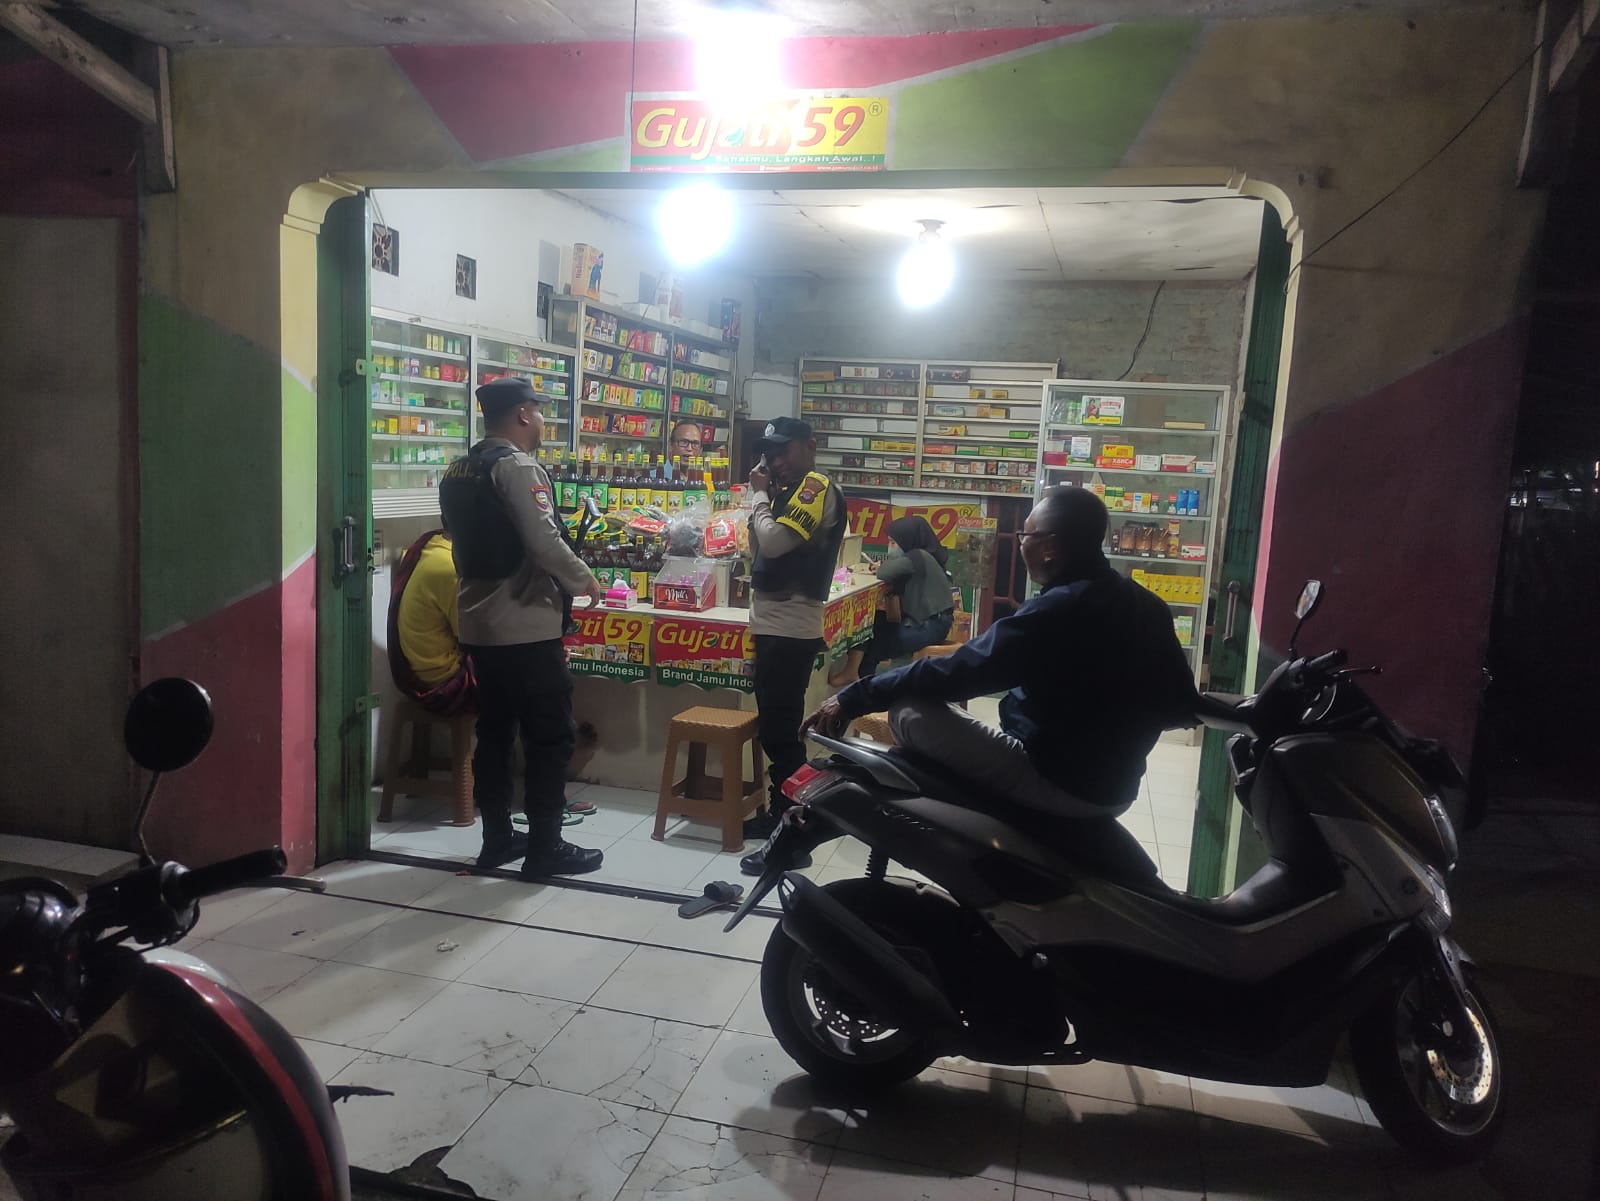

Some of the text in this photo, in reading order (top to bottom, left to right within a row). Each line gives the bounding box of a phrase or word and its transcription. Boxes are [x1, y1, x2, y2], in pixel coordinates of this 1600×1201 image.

[796, 106, 866, 147] 59
[573, 616, 643, 641] ati 59
[657, 623, 741, 653] Gujati
[567, 660, 645, 678] amu Indonesia
[662, 669, 694, 682] Brand
[697, 672, 726, 685] Jamu
